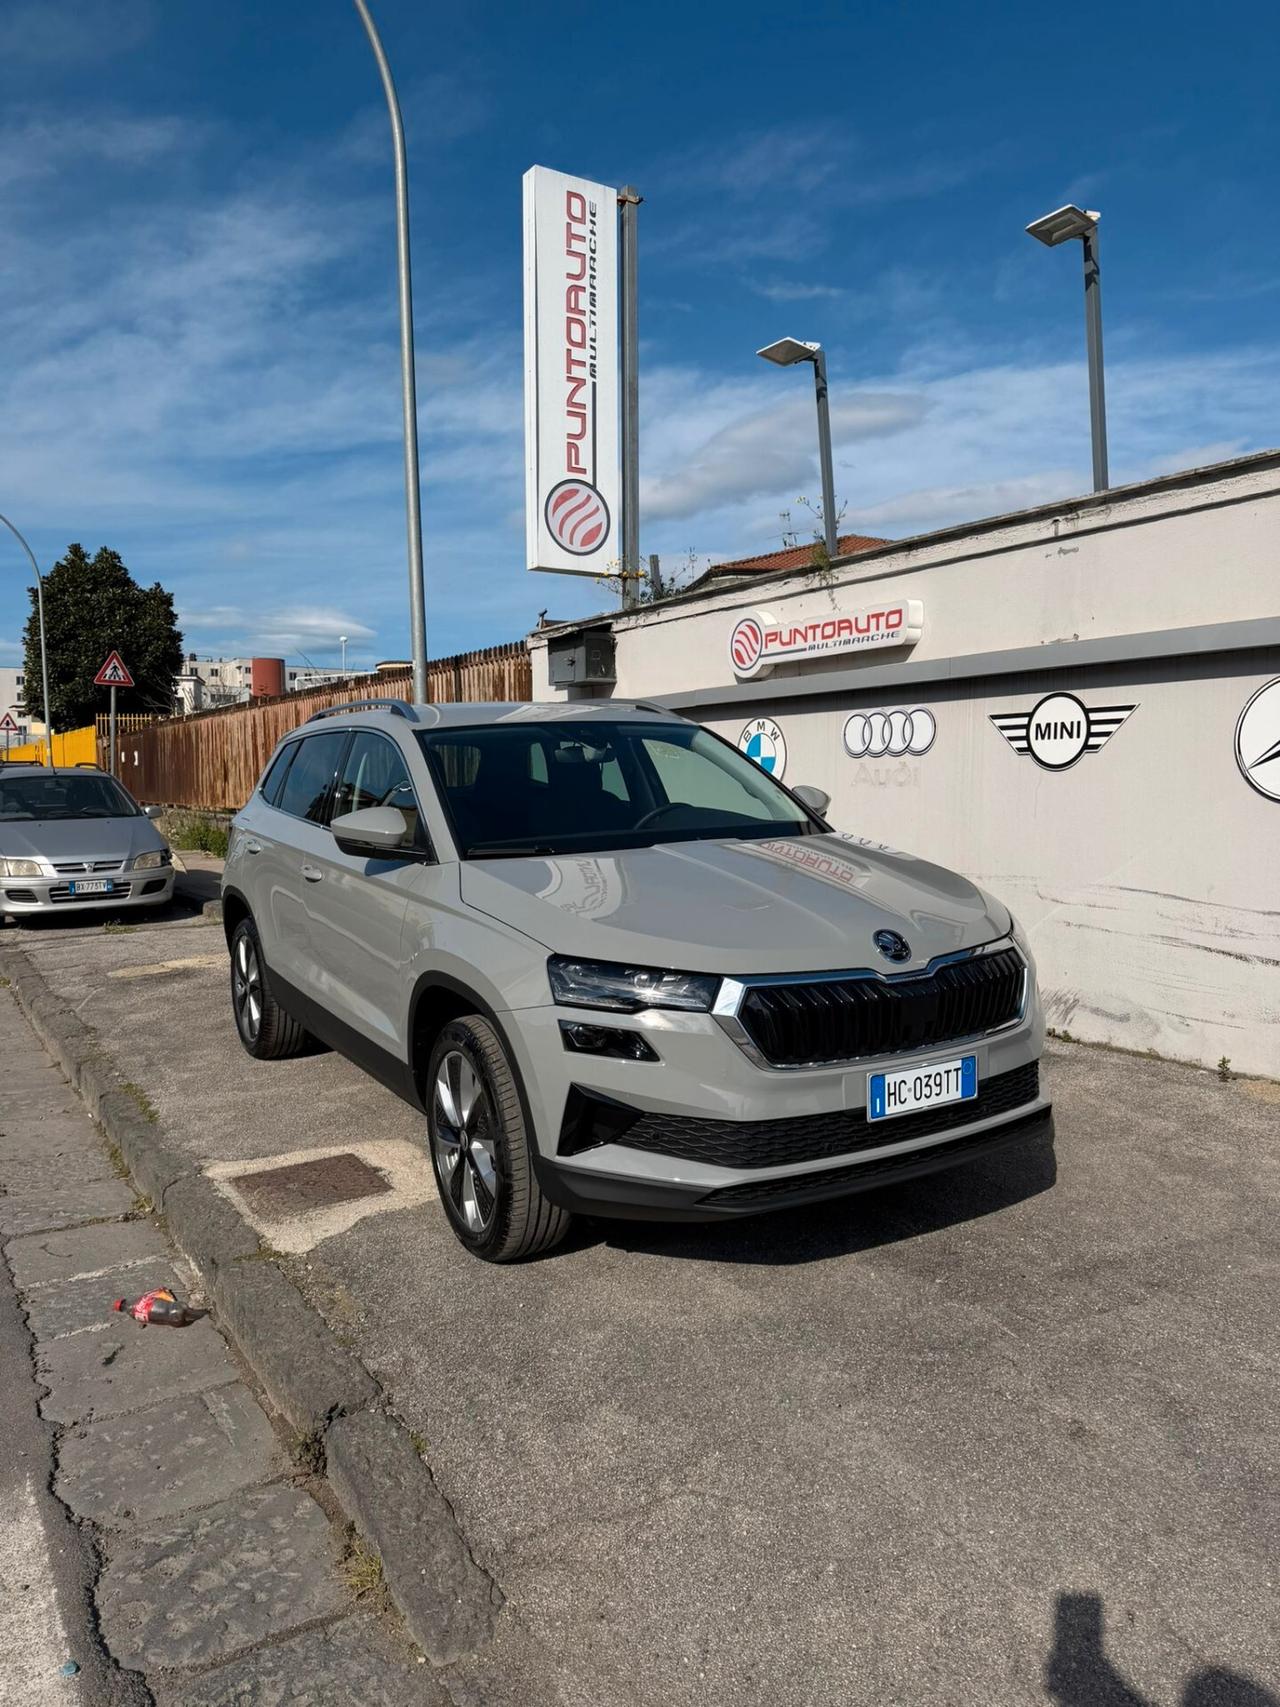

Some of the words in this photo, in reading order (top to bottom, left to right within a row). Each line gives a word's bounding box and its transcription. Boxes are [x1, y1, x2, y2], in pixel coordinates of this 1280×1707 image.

[589, 200, 598, 380] MULTIMARCHE
[566, 190, 587, 475] PUNTOAUTO
[764, 608, 903, 649] PUNTOAUTO
[807, 630, 901, 651] MULTIMARCHE
[743, 720, 780, 743] BMW
[1034, 720, 1081, 741] MINI
